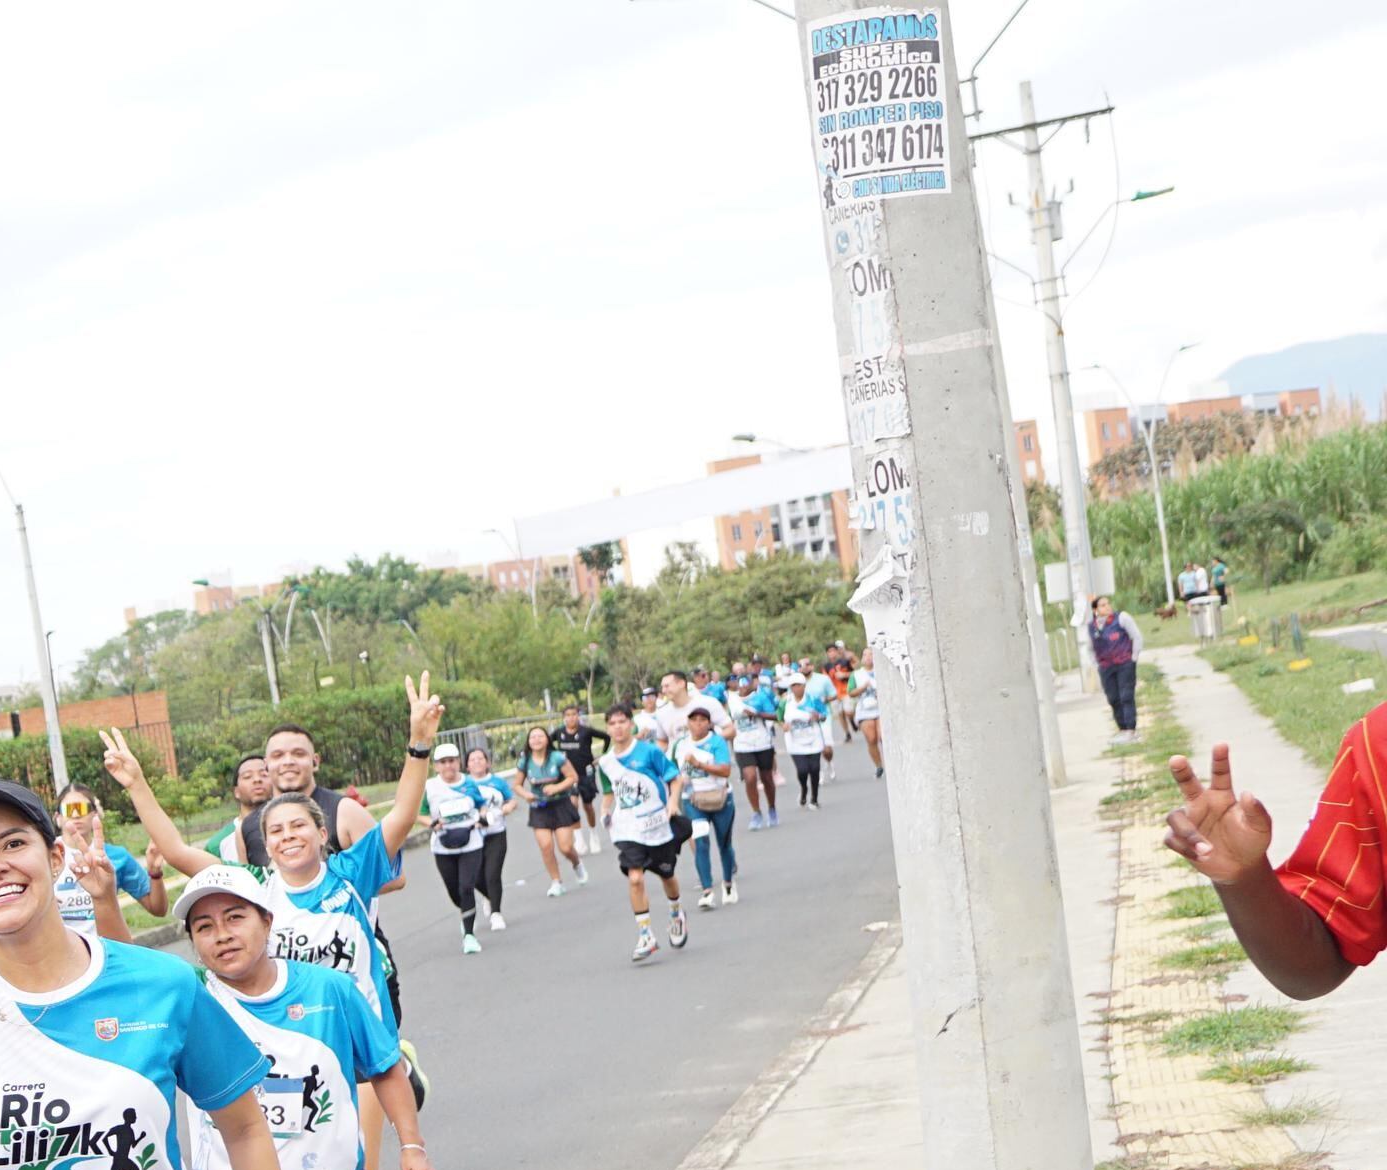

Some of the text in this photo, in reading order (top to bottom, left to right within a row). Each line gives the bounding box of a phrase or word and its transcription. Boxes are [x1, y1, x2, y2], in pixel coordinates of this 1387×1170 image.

[812, 14, 938, 55] DESTAPAMOS
[840, 42, 907, 61] SUPER
[817, 66, 937, 112] 317 329 2266
[819, 101, 943, 135] SIN ROMPER PISO
[831, 123, 944, 172] 311 347 6174
[2, 1082, 46, 1092] Carrera
[0, 1092, 71, 1129] Río
